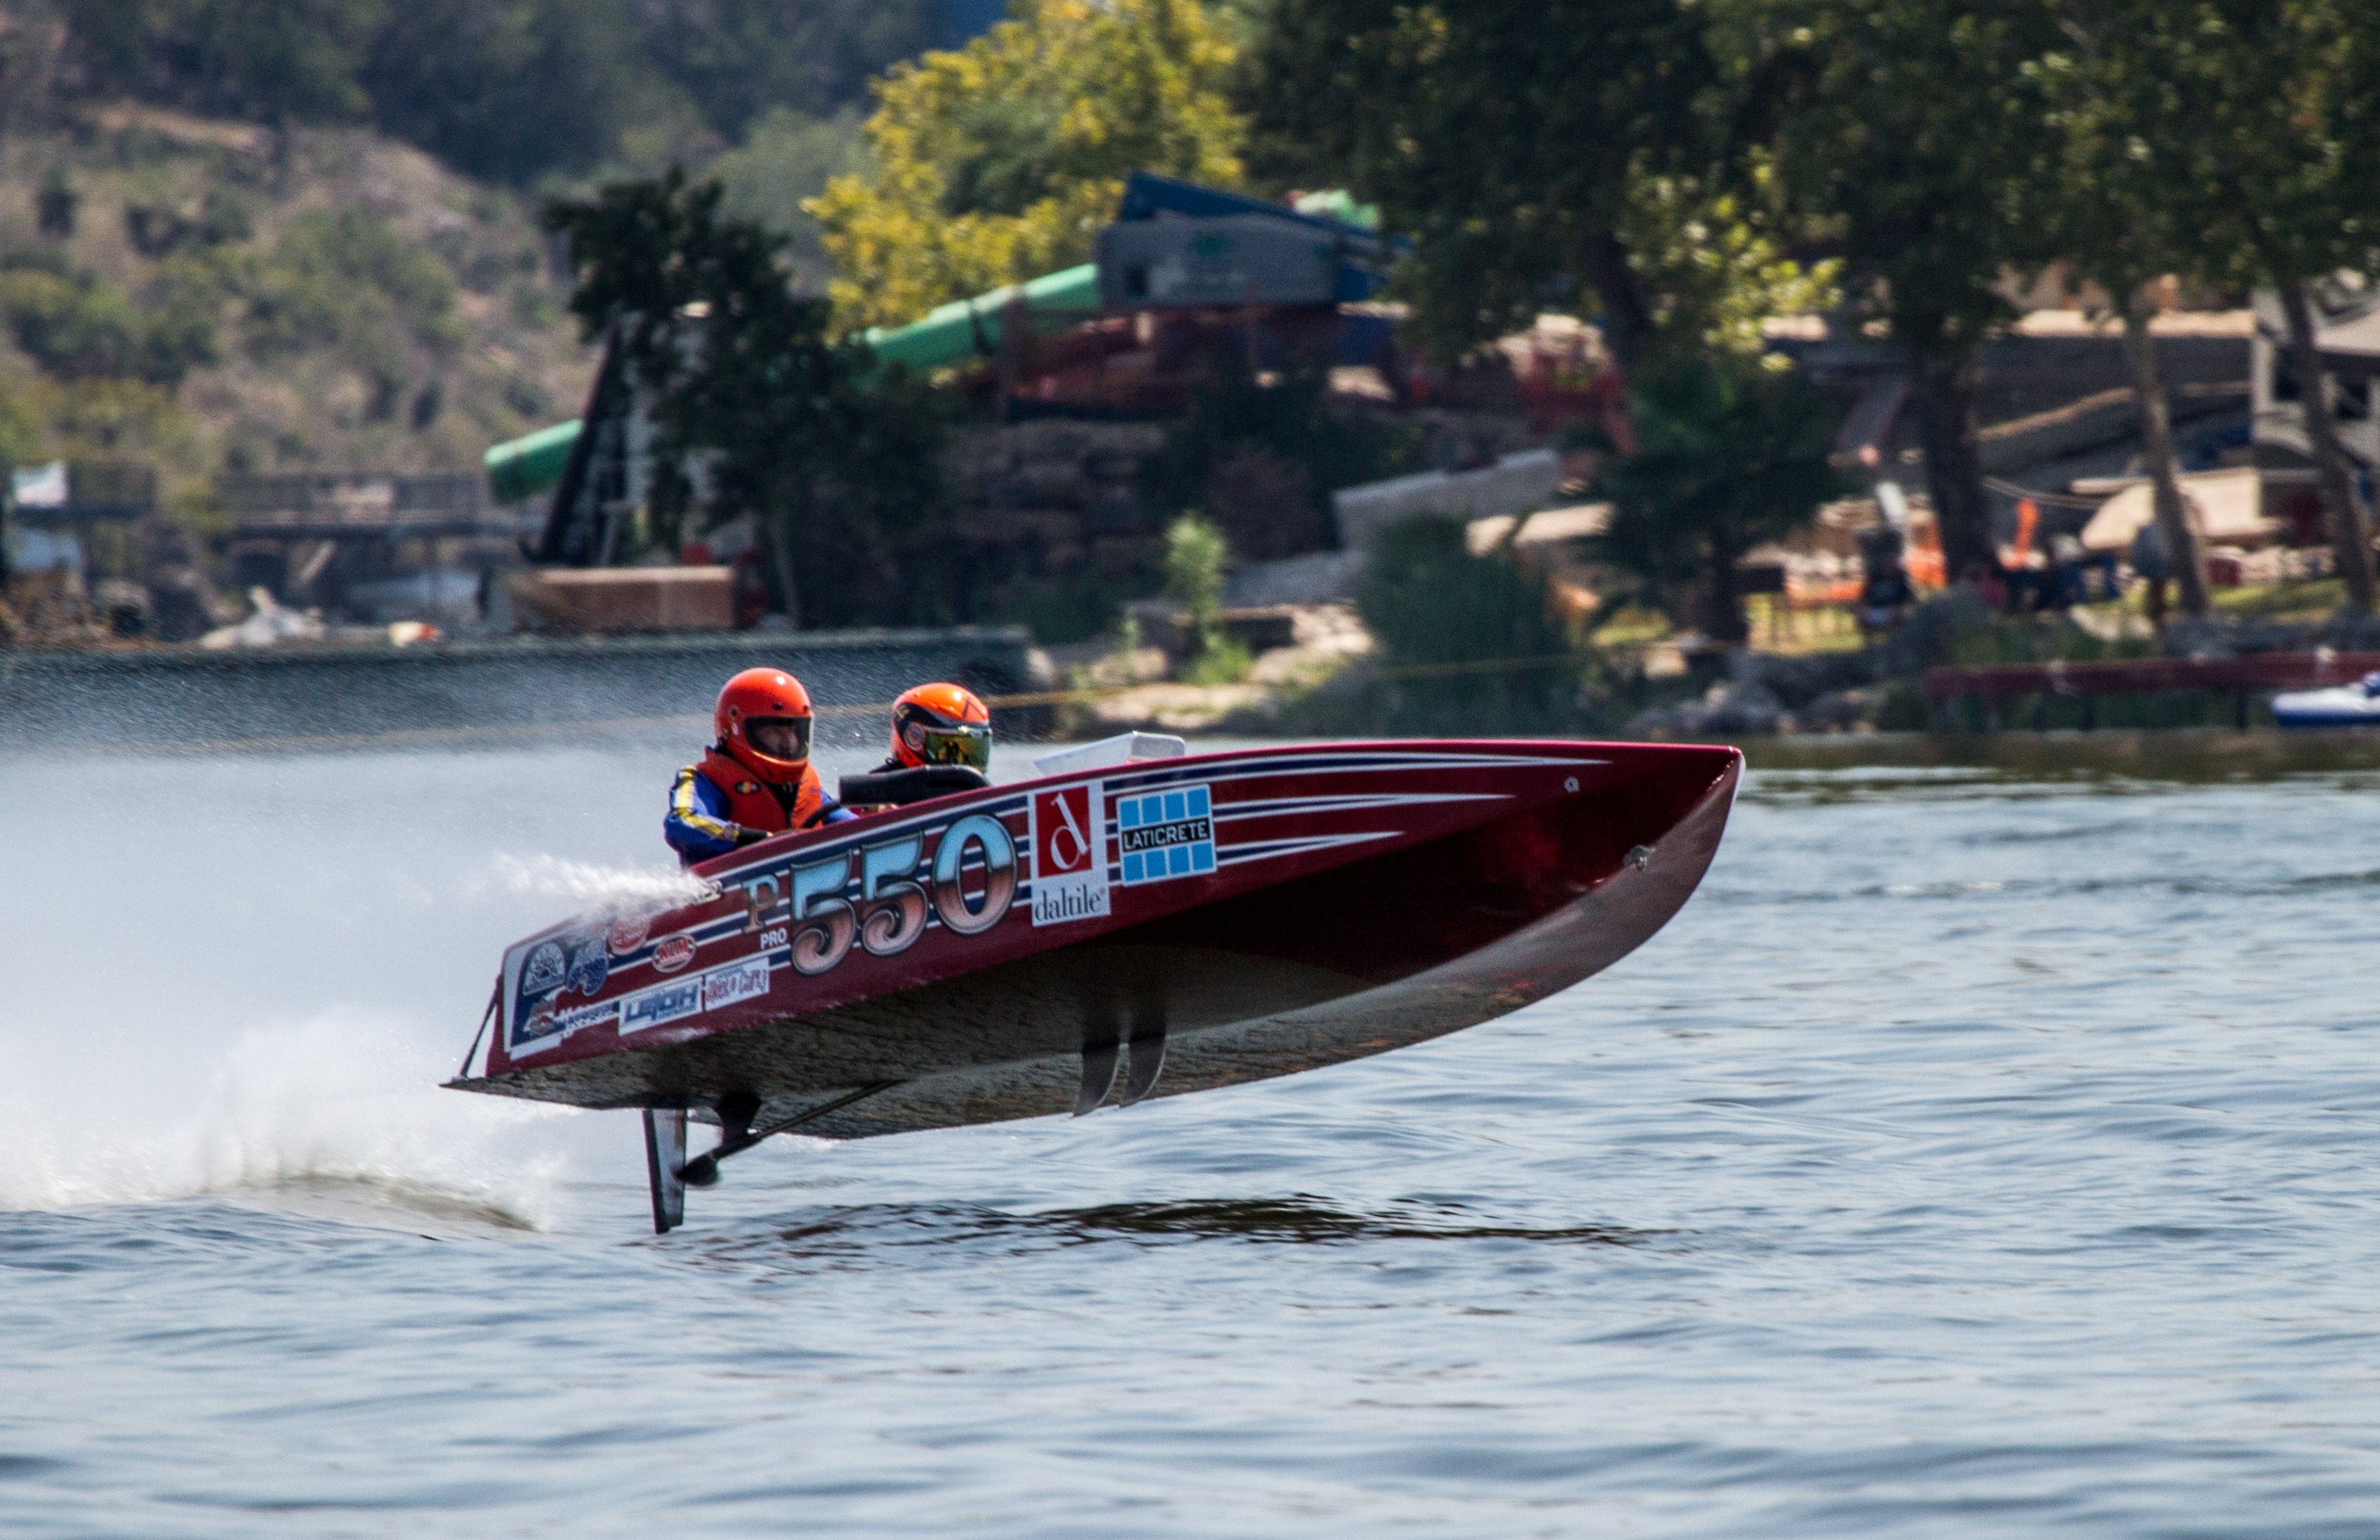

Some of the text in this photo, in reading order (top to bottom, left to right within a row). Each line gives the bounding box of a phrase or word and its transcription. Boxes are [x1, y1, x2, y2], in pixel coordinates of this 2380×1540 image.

[1123, 823, 1208, 850] LATICRETE
[740, 812, 1020, 977] P 550
[759, 928, 788, 950] PRO
